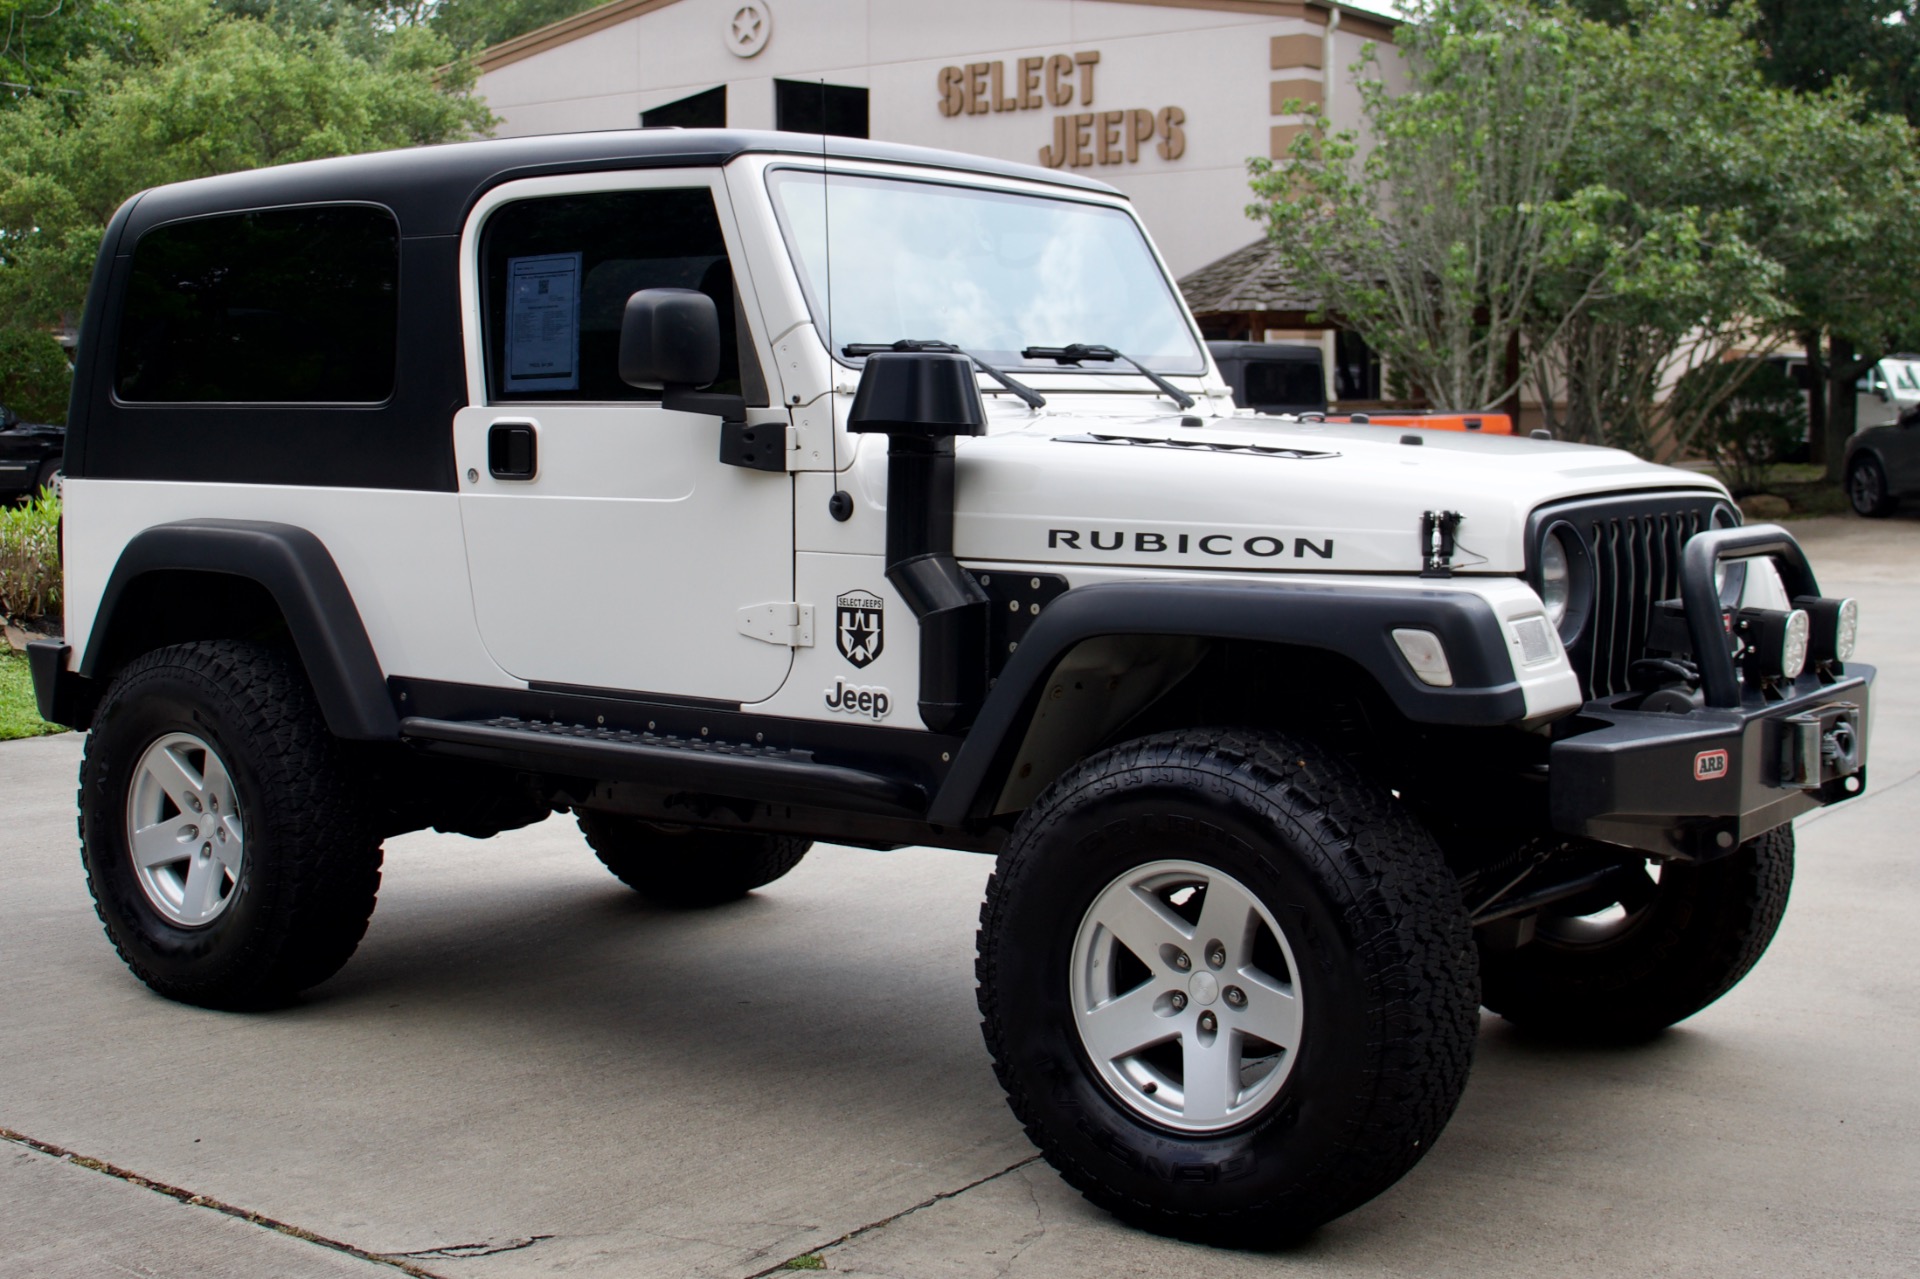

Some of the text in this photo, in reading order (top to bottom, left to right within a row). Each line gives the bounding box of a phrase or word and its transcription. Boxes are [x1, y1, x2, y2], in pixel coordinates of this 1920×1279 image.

[937, 50, 1101, 118] SELECT
[1038, 106, 1186, 168] JEEPS
[1048, 529, 1334, 559] RUBICON
[839, 598, 882, 608] SELECT JEEPS
[826, 682, 888, 718] Jeep
[1699, 755, 1724, 773] ARB
